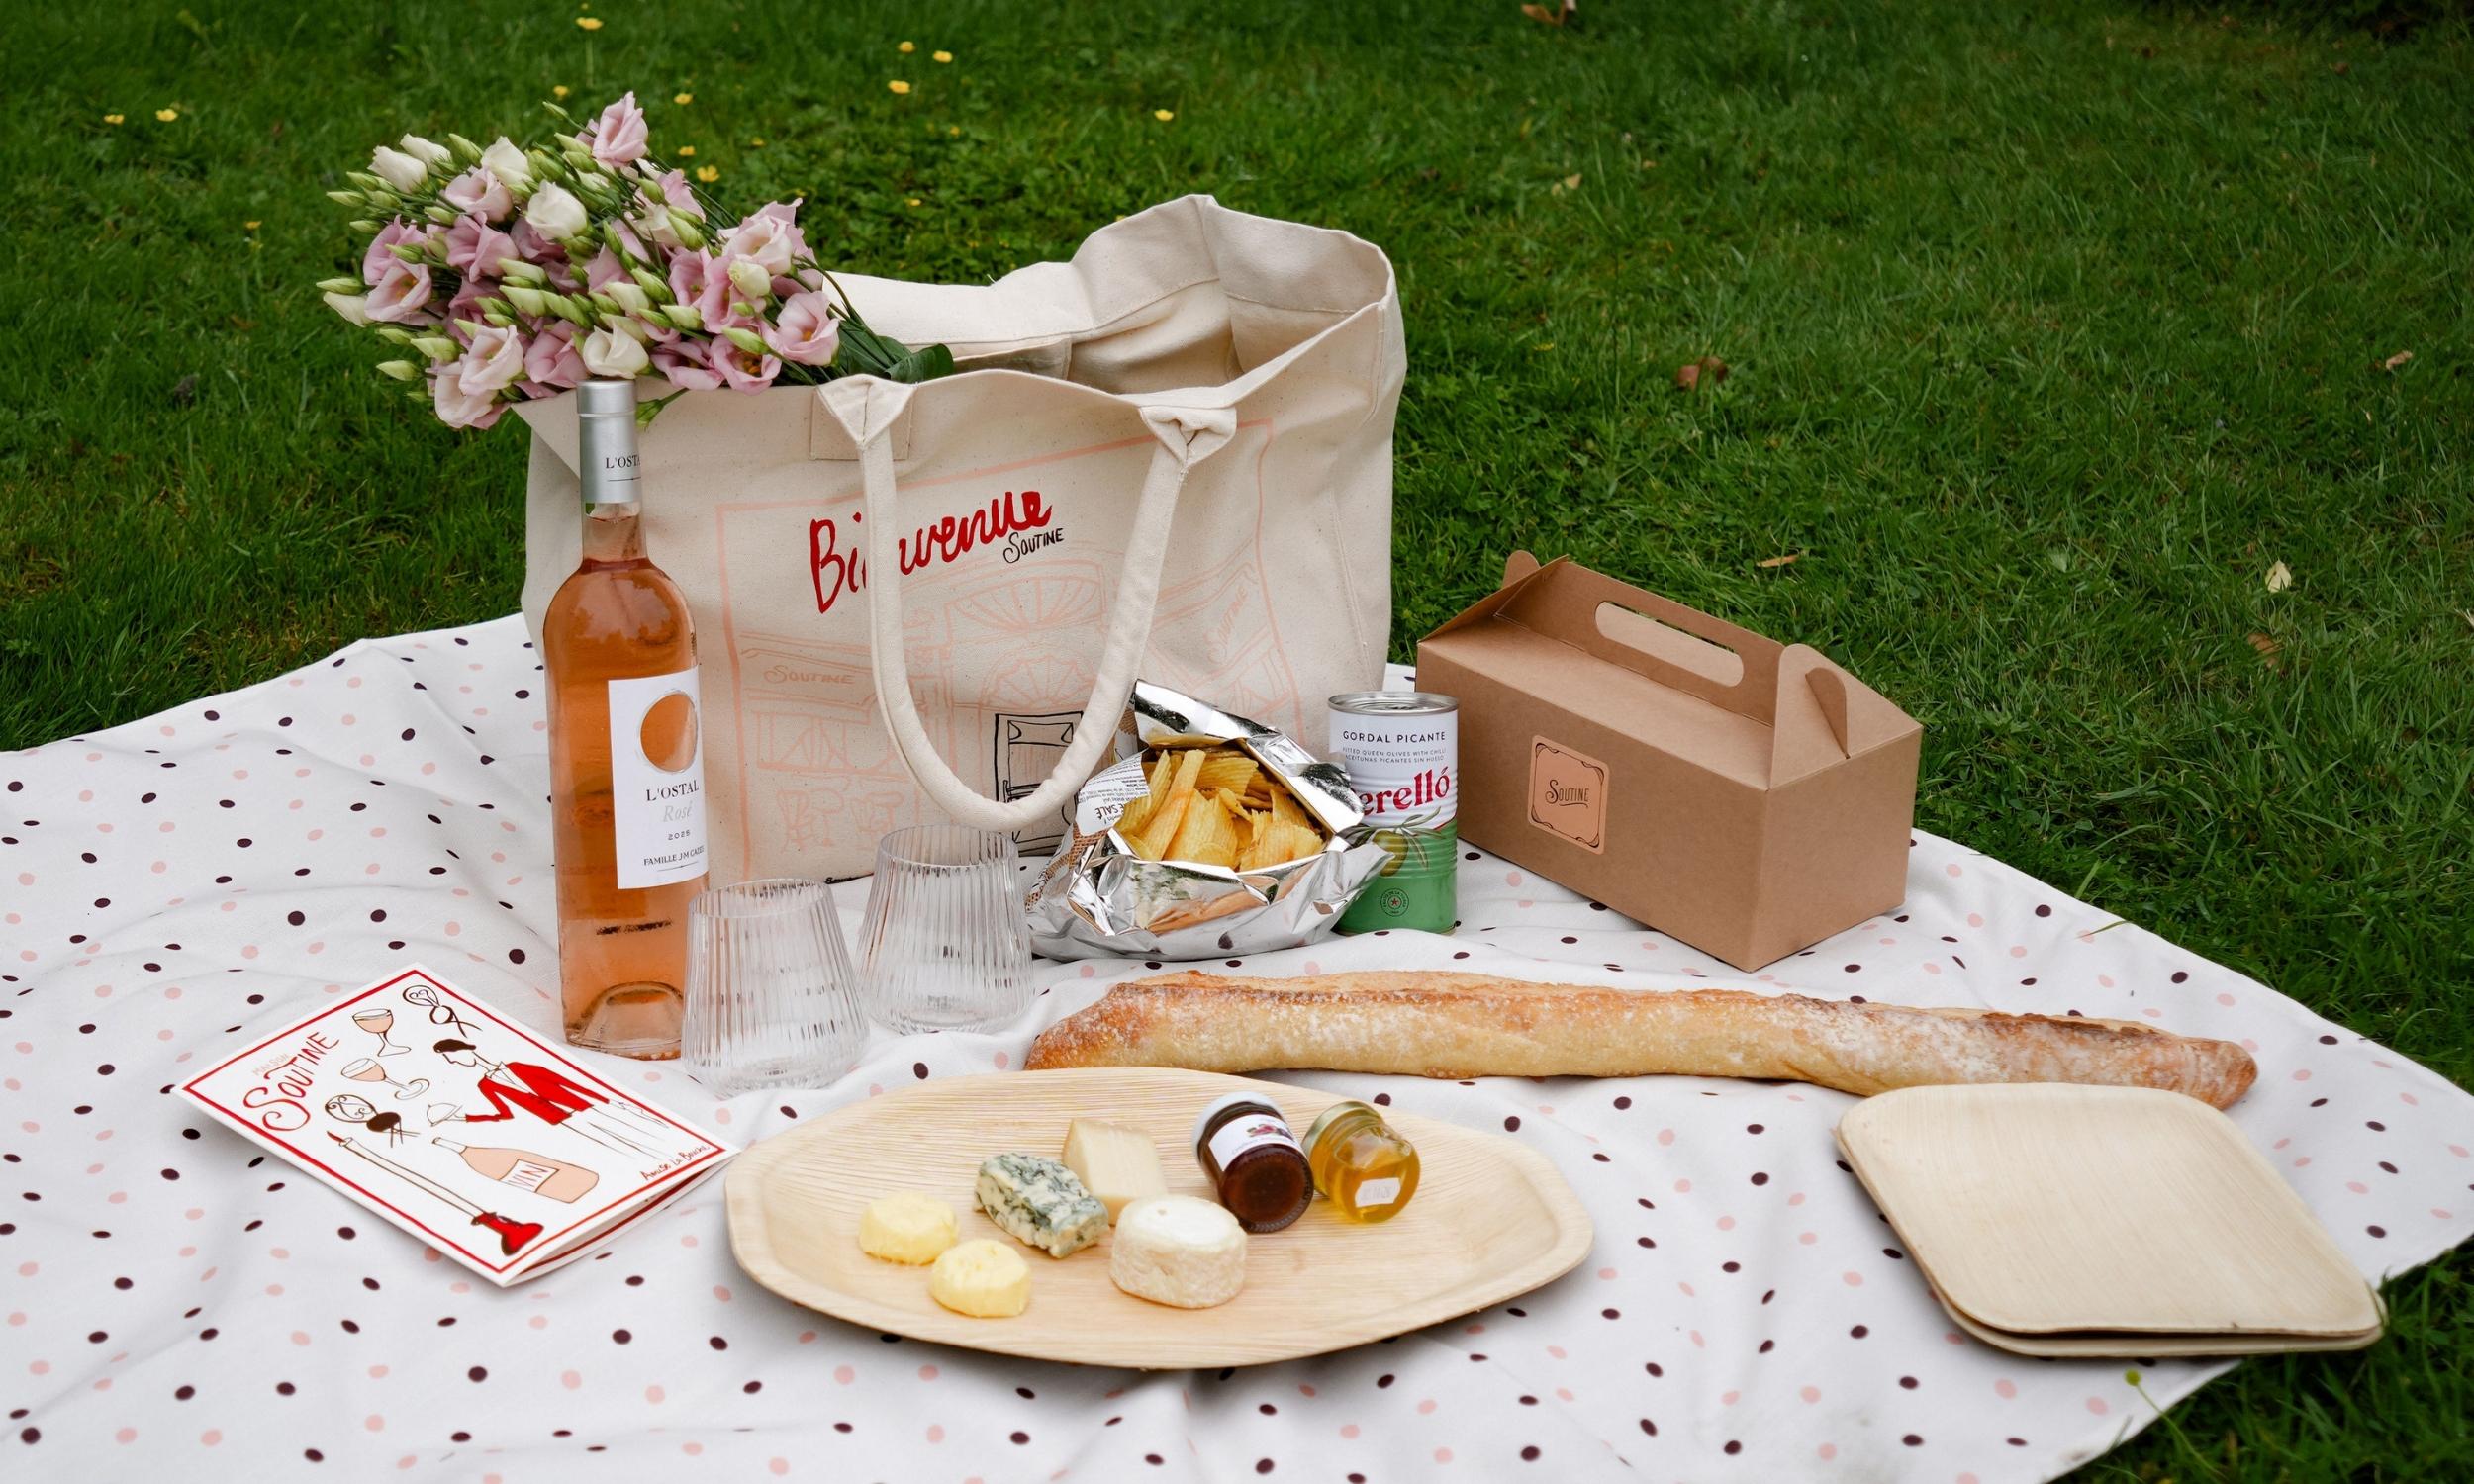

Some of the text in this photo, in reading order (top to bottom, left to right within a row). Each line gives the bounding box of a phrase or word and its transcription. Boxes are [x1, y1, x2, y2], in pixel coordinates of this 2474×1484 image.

[809, 491, 1053, 614] Bivenue
[1002, 527, 1065, 564] SOUTINE
[1343, 730, 1446, 743] GORDAL PICANTE
[645, 779, 700, 802] L'OSTAL
[1356, 766, 1451, 816] erelló
[1544, 779, 1590, 805] SOUTINE
[662, 799, 694, 823] Rosé
[643, 853, 677, 867] FAMILLE
[243, 1031, 340, 1132] SOUTINE
[507, 1164, 549, 1188] VIN
